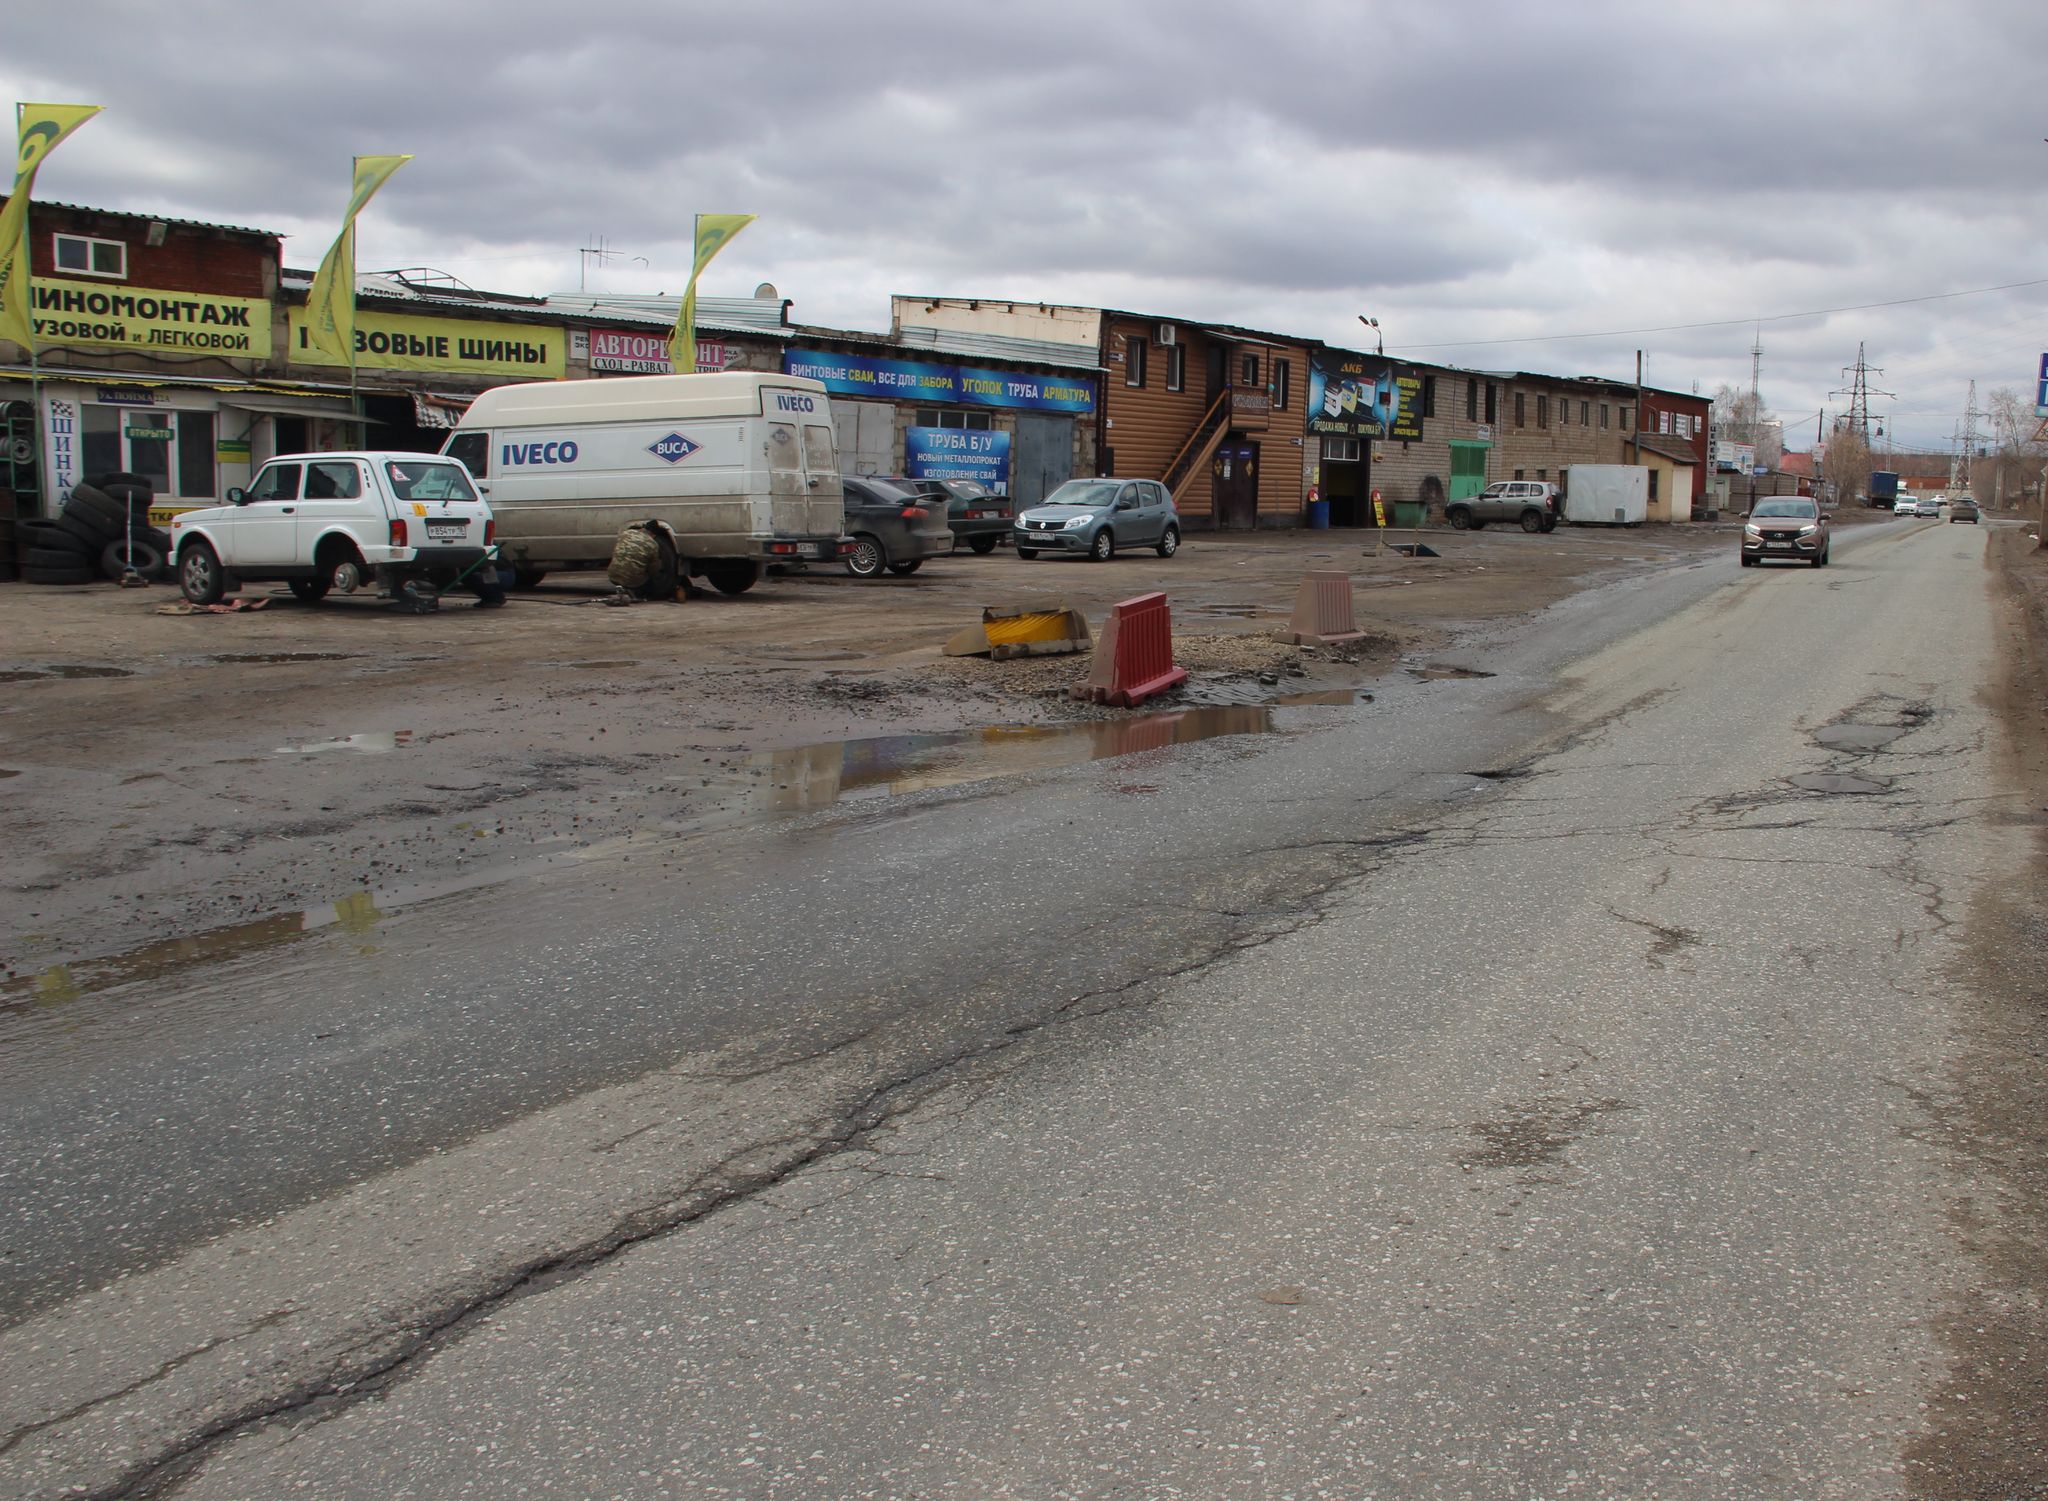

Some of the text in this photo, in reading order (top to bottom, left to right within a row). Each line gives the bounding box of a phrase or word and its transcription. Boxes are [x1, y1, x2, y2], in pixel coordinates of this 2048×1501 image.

[148, 328, 249, 350] ЛЕГКОВОЙ
[594, 333, 722, 363] АВТОРЕНТ
[458, 338, 546, 364] ШИНЫ
[791, 363, 953, 389] ВИНТОВЫЕ СВАИ, ВСЕ ДЛЯ ЗАБОРА
[1340, 362, 1363, 374] АКБ
[962, 377, 1091, 403] УГОЛОК ТРУБА АРМАТУРА
[777, 394, 814, 413] IVECO
[129, 428, 171, 438] ОТКРЫТО
[928, 433, 993, 453] ТРУБА Б/У
[502, 441, 579, 466] IVECO
[657, 441, 690, 455] BUCA
[1709, 425, 1717, 468] ЦЕМЕНТ
[917, 452, 1001, 465] НОВЫЙ МЕТАЛЛОПРОКАТ
[924, 469, 997, 480] ИЗГОТОВЛЕНИЕ СВАЙ
